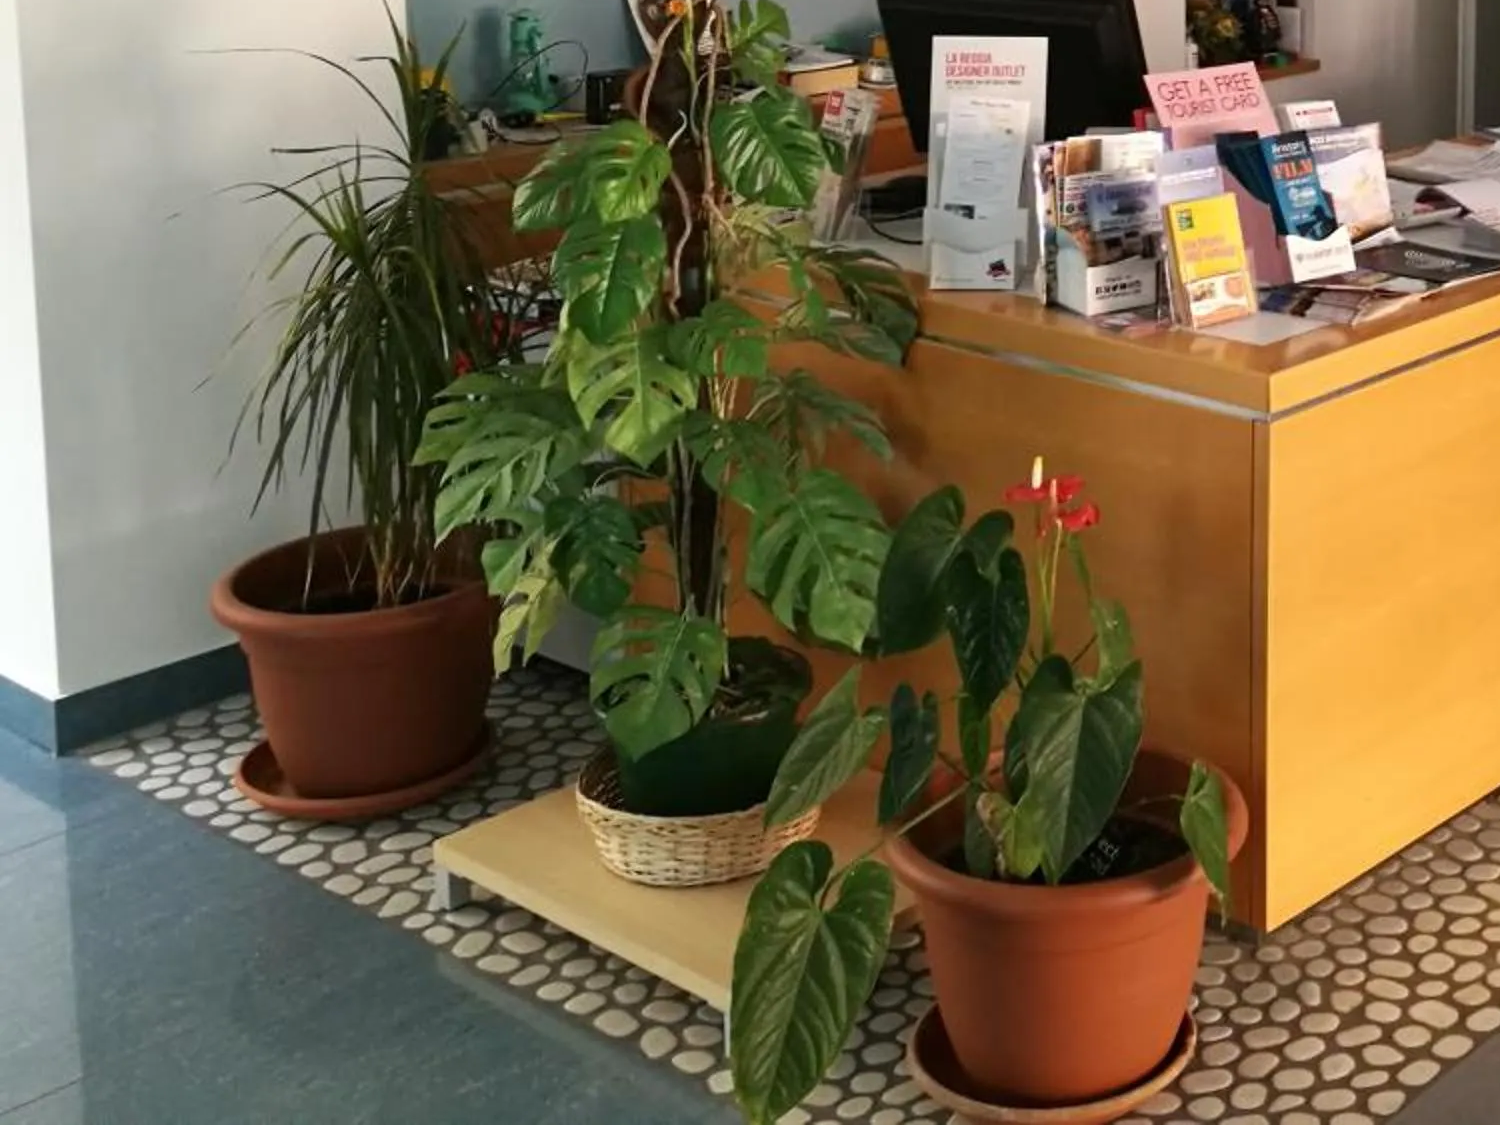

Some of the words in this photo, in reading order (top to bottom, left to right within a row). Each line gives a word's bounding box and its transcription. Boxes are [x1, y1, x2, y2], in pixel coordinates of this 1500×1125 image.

[945, 65, 990, 78] DESIGNER
[1157, 80, 1193, 103] GET
[1199, 78, 1212, 98] A
[1214, 72, 1255, 95] FREE
[1164, 98, 1218, 120] TOURIST
[1220, 91, 1260, 112] CARD
